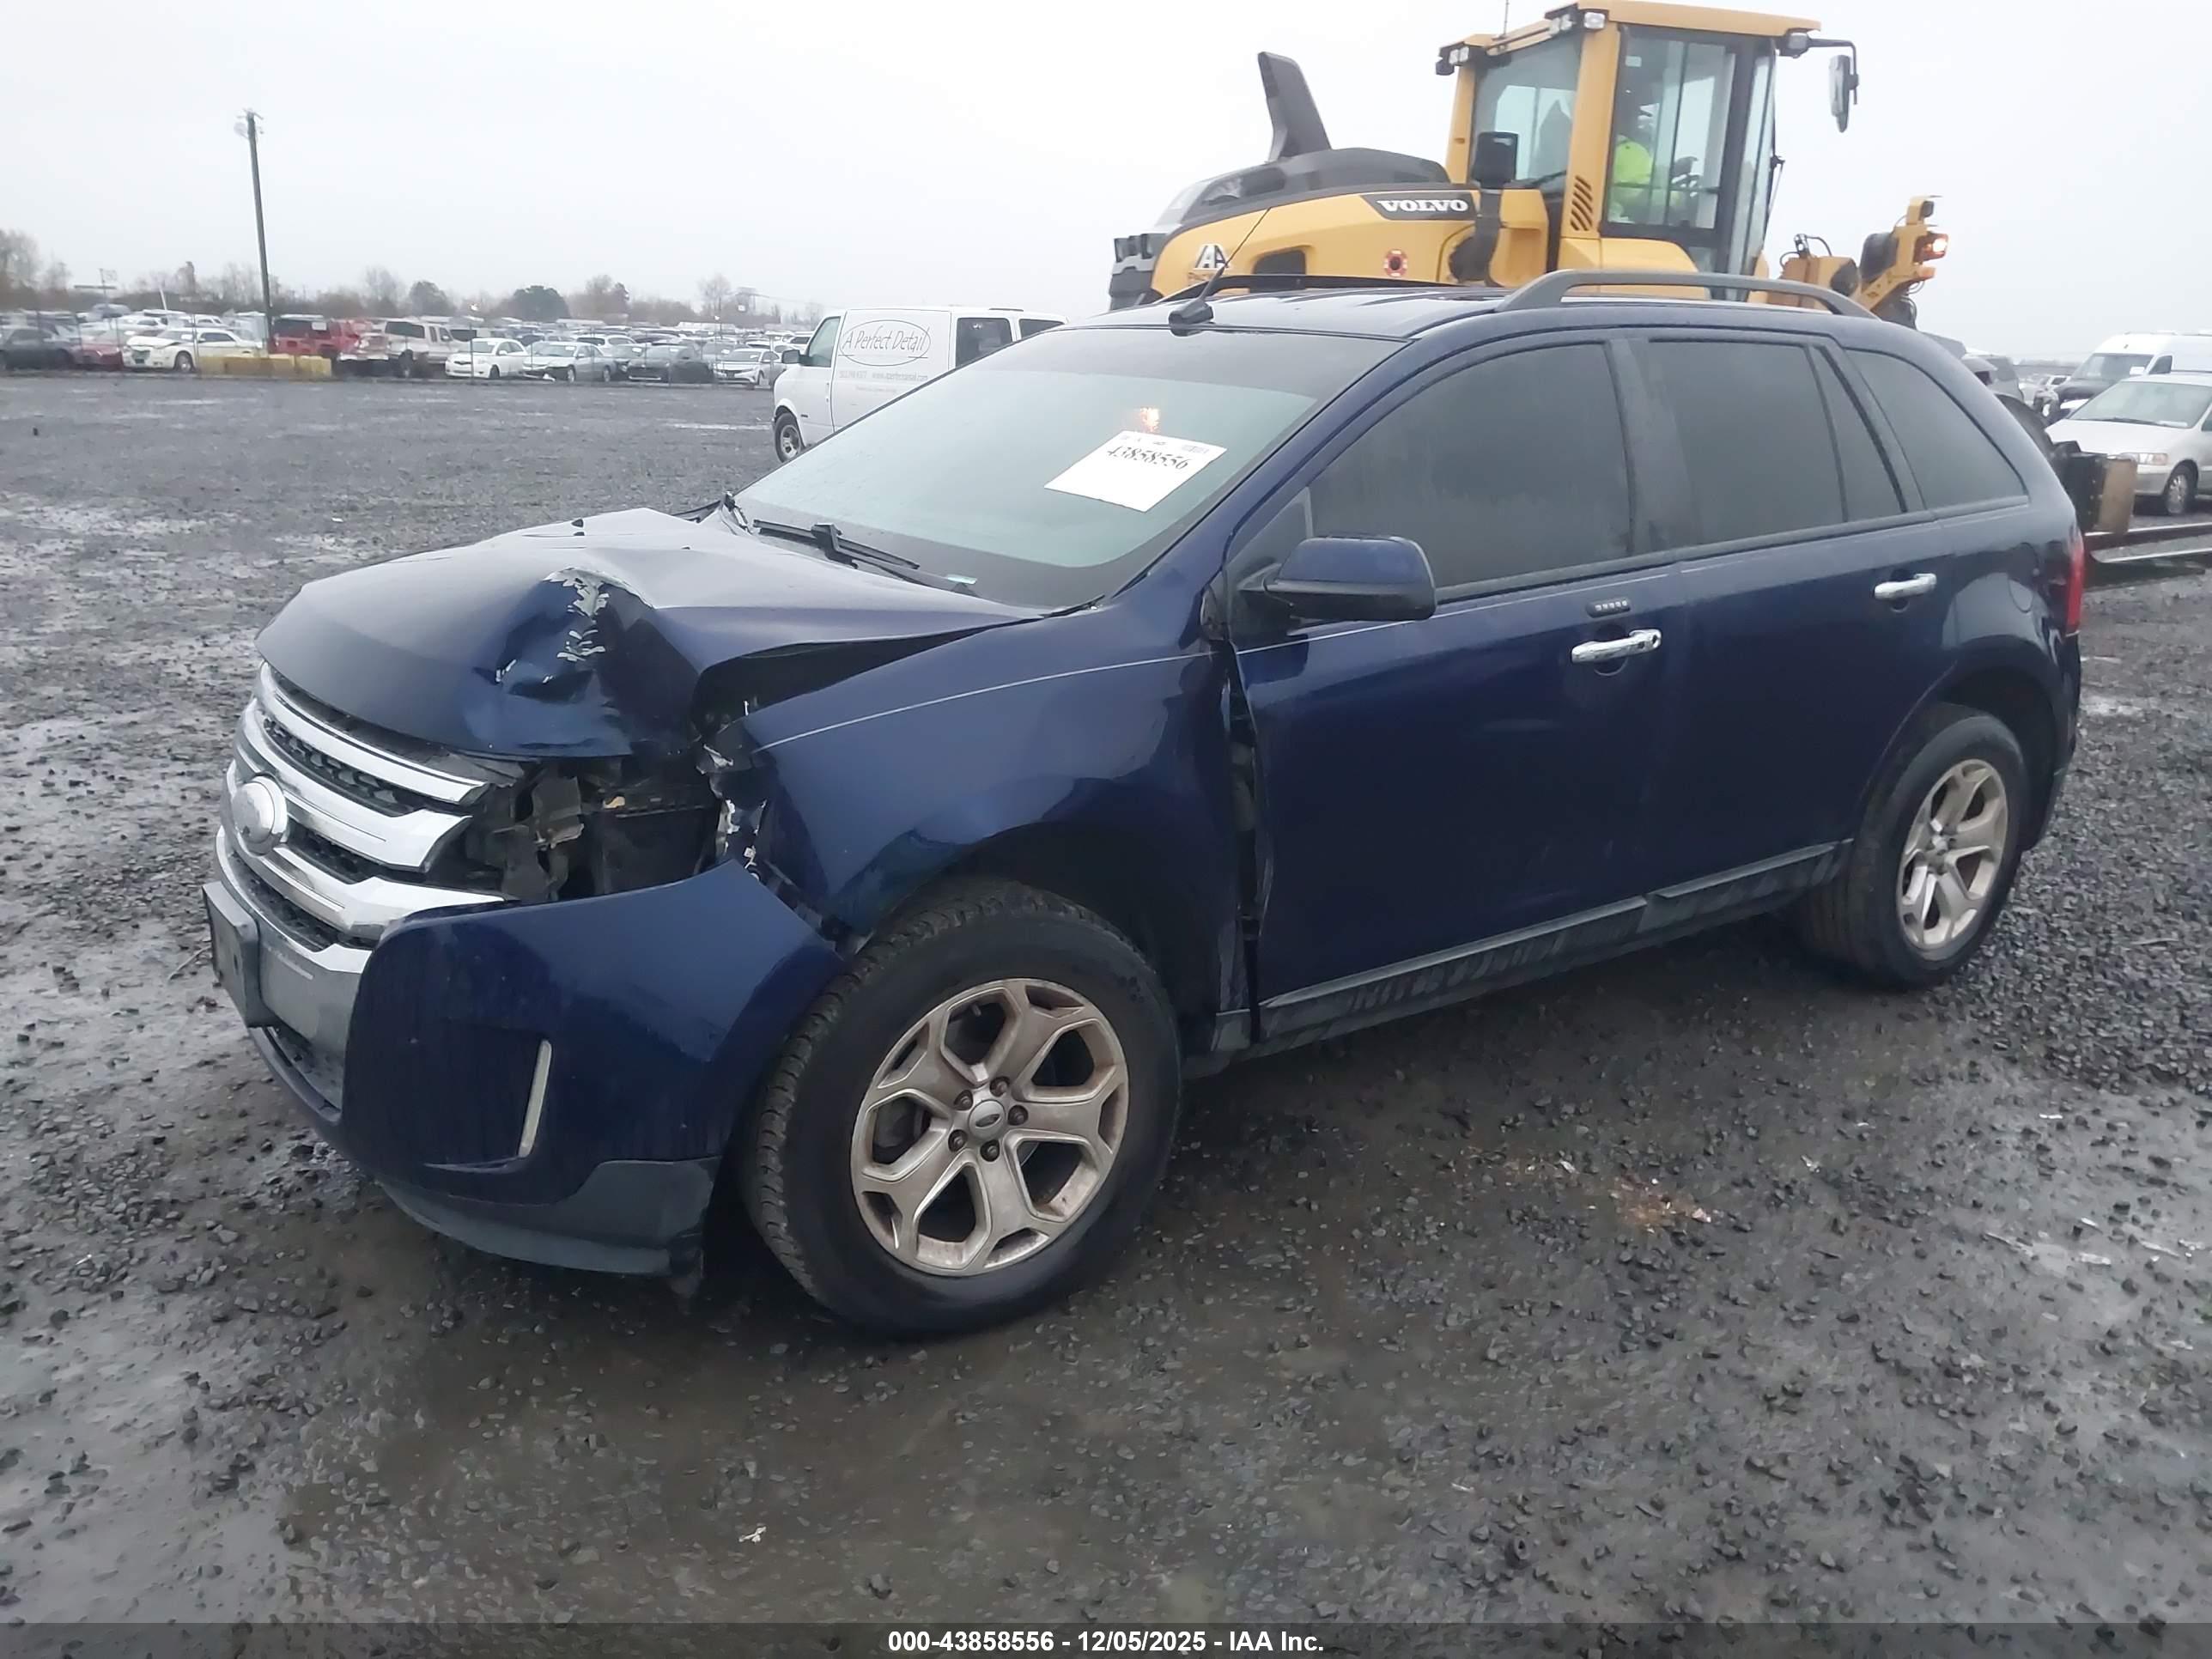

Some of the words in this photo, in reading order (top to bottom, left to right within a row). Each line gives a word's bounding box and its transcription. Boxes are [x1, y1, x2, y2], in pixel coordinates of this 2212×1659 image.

[1376, 199, 1469, 212] VOLVO
[842, 331, 854, 349] A
[854, 325, 893, 350] Perfect
[891, 326, 931, 353] Detail
[1107, 445, 1193, 470] 43858556
